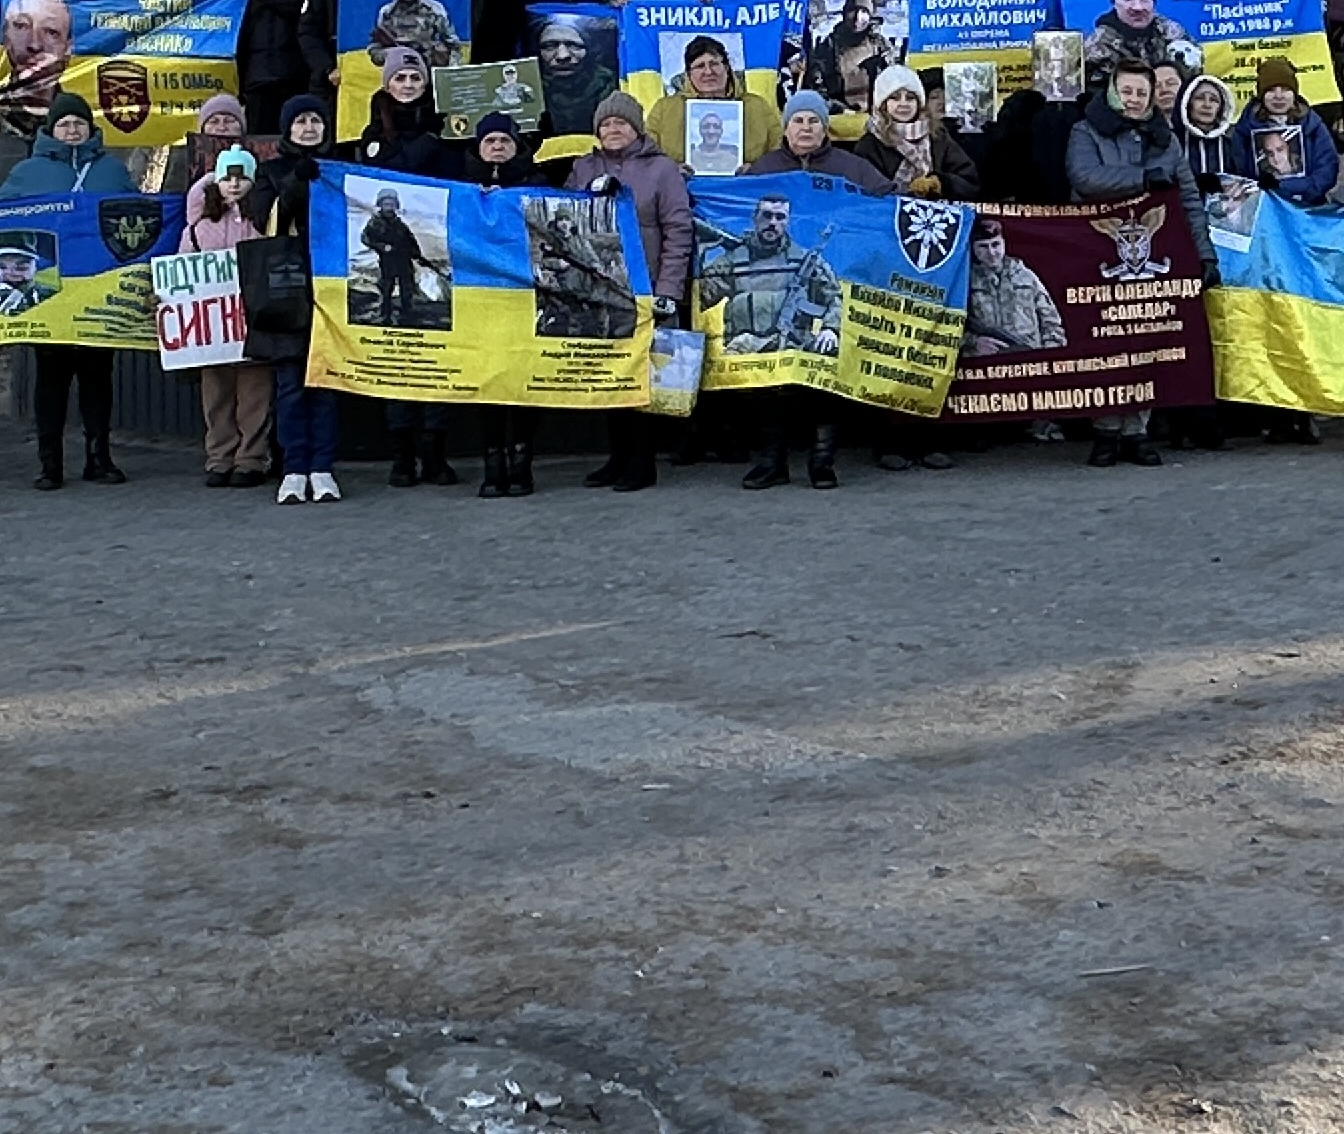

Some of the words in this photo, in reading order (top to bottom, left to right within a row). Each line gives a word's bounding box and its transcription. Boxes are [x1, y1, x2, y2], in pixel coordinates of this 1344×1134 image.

[736, 2, 780, 26] АЛЕ
[920, 9, 1047, 29] МИХАЙЛОВИЧ
[1114, 278, 1202, 299] ОЛЕКСАНДР
[1032, 386, 1106, 411] НАШОГО
[1108, 380, 1156, 406] ГЕРОЯ
